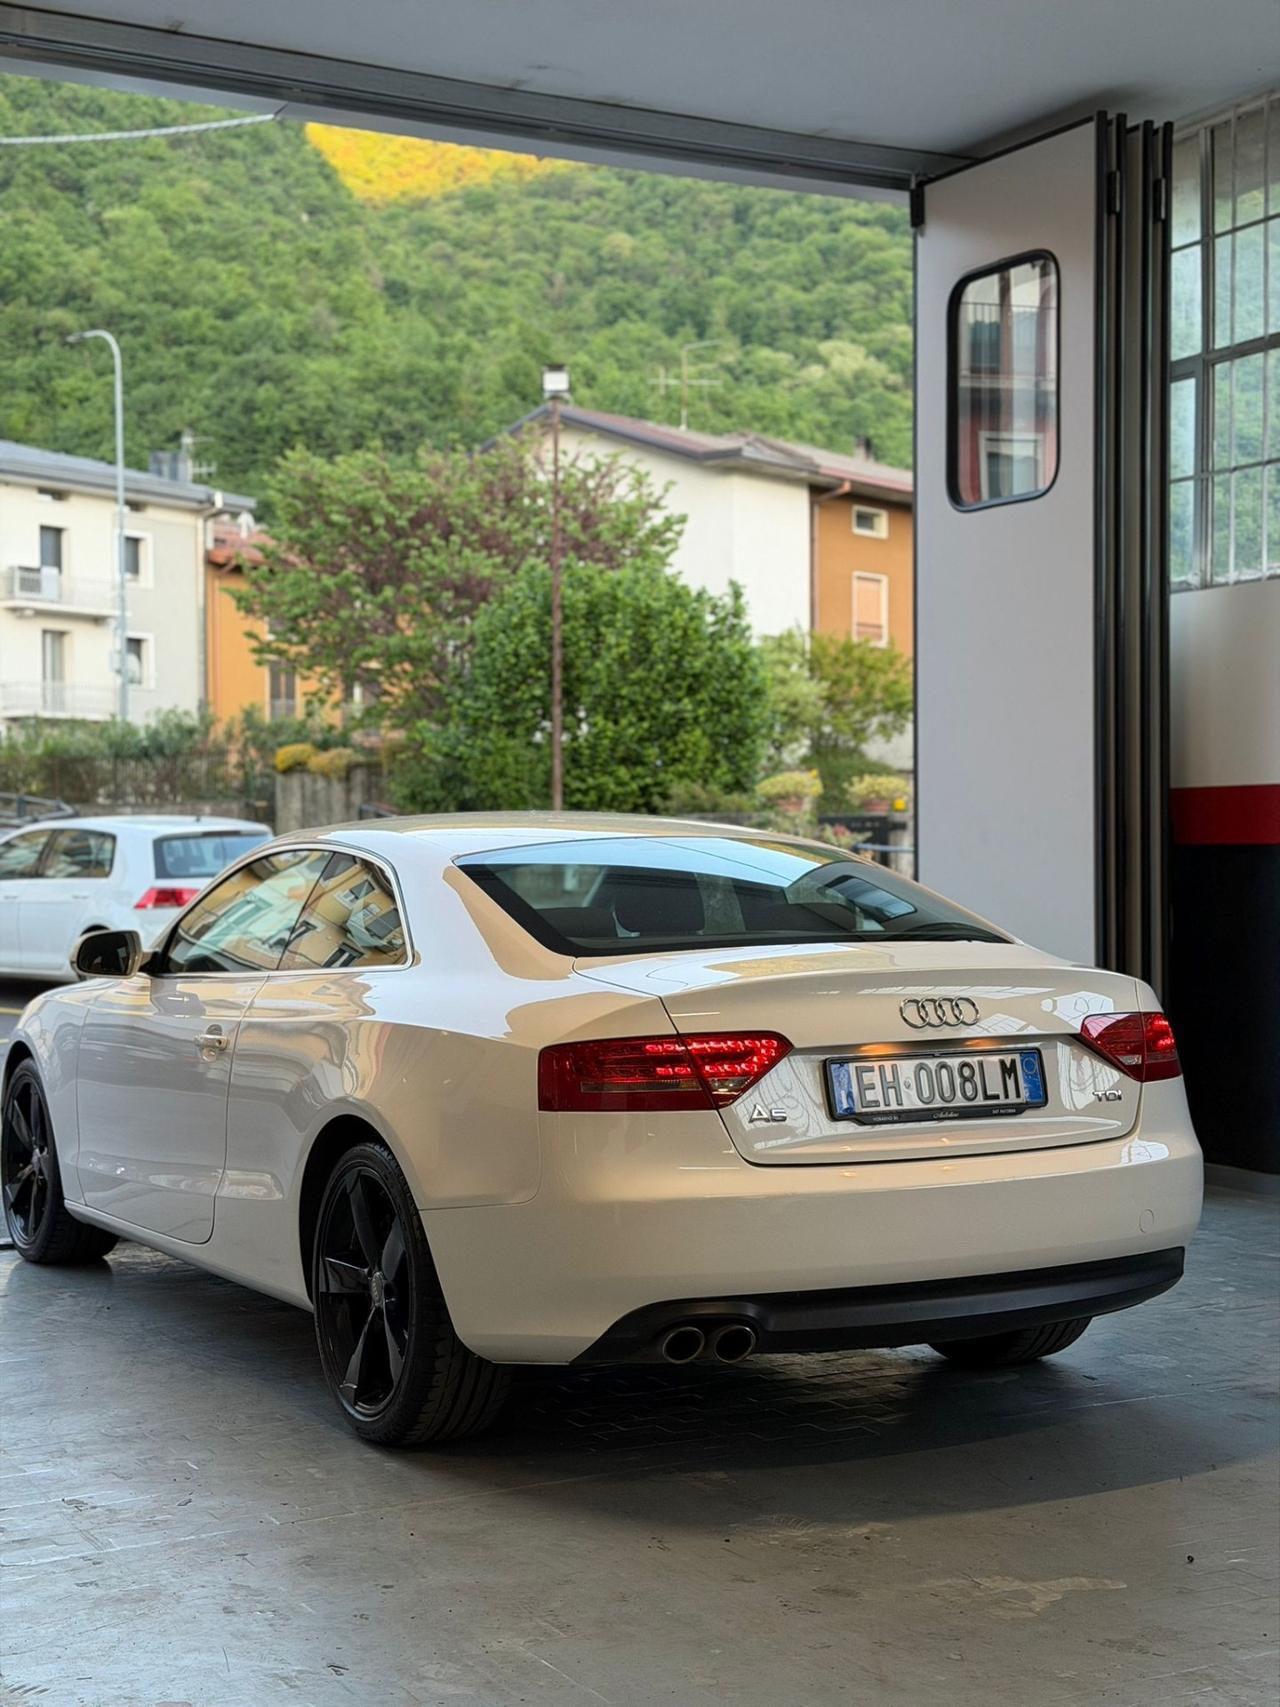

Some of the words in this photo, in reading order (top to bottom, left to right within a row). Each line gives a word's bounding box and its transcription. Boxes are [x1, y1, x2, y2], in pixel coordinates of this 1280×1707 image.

[855, 1063, 903, 1108] EH
[914, 1058, 1021, 1105] 008LM
[748, 1103, 787, 1123] A5
